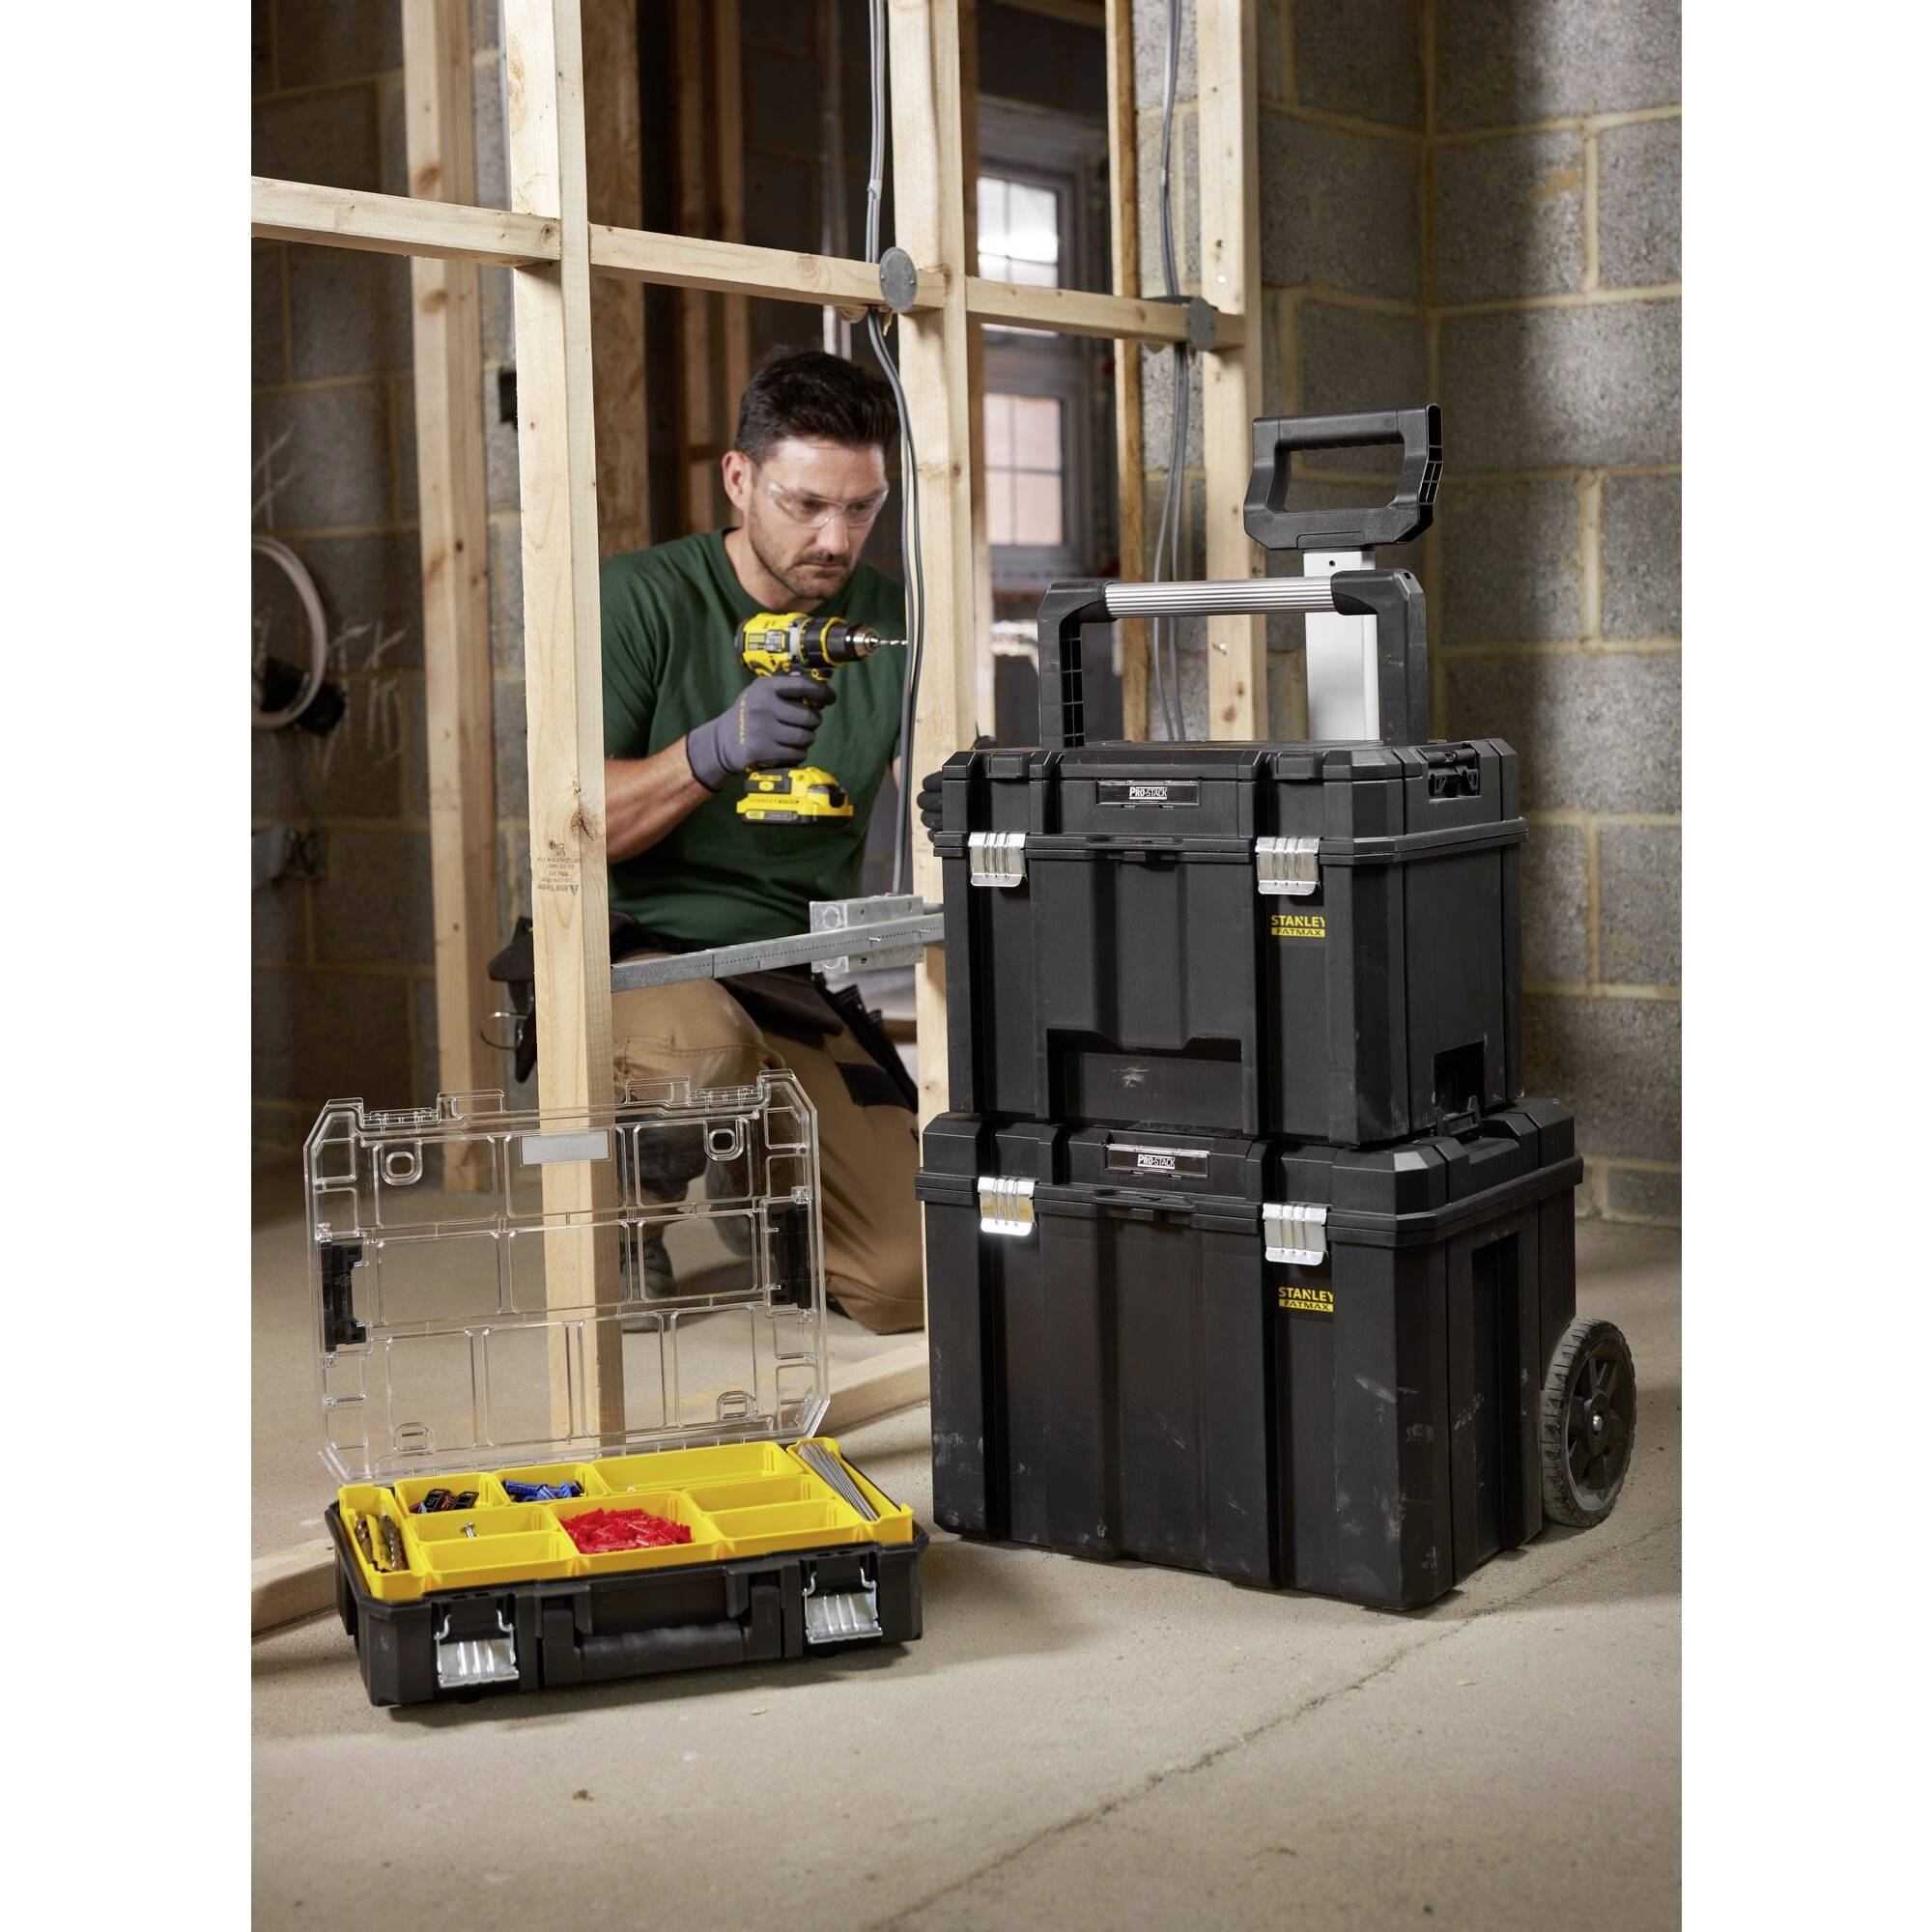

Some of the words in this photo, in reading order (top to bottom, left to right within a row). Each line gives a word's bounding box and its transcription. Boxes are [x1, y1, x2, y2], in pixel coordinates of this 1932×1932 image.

[1270, 914, 1325, 927] STANLEY
[1278, 1286, 1333, 1303] STANLEY
[1284, 1300, 1329, 1311] FATMAX
